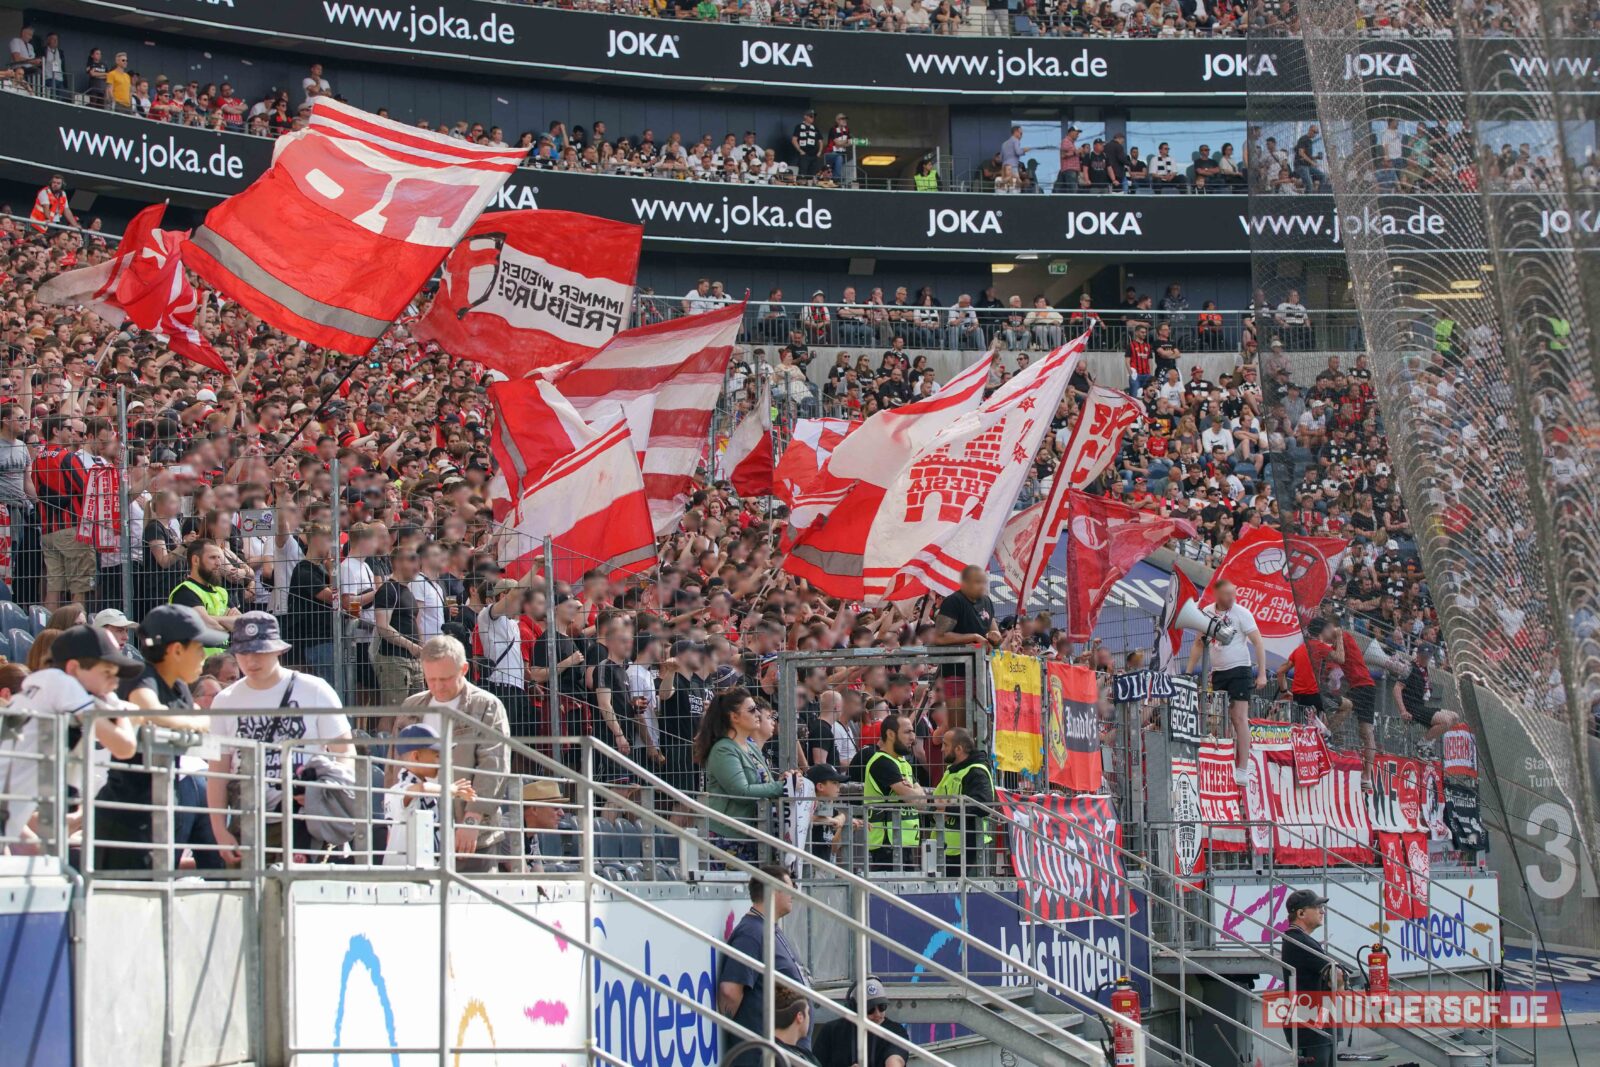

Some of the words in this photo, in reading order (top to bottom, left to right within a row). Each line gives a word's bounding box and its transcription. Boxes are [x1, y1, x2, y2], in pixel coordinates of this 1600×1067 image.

[323, 1, 515, 45] www.joka.de
[607, 30, 676, 58] JOKA
[740, 40, 812, 67] JOKA
[906, 48, 1107, 84] www.joka.de
[1203, 54, 1277, 80] JOKA
[1344, 53, 1416, 79] JOKA
[59, 126, 243, 180] www.joka.de
[487, 185, 538, 210] KA
[631, 196, 831, 233] www.joka.de
[927, 209, 1002, 236] JOKA
[1066, 211, 1142, 238] JOKA
[1239, 207, 1444, 243] www.joka.de
[1524, 757, 1571, 771] Stadion
[1528, 775, 1569, 788] Tunnel
[1400, 897, 1466, 962] indeed
[1051, 919, 1121, 995] finden
[594, 917, 718, 1067] indeed
